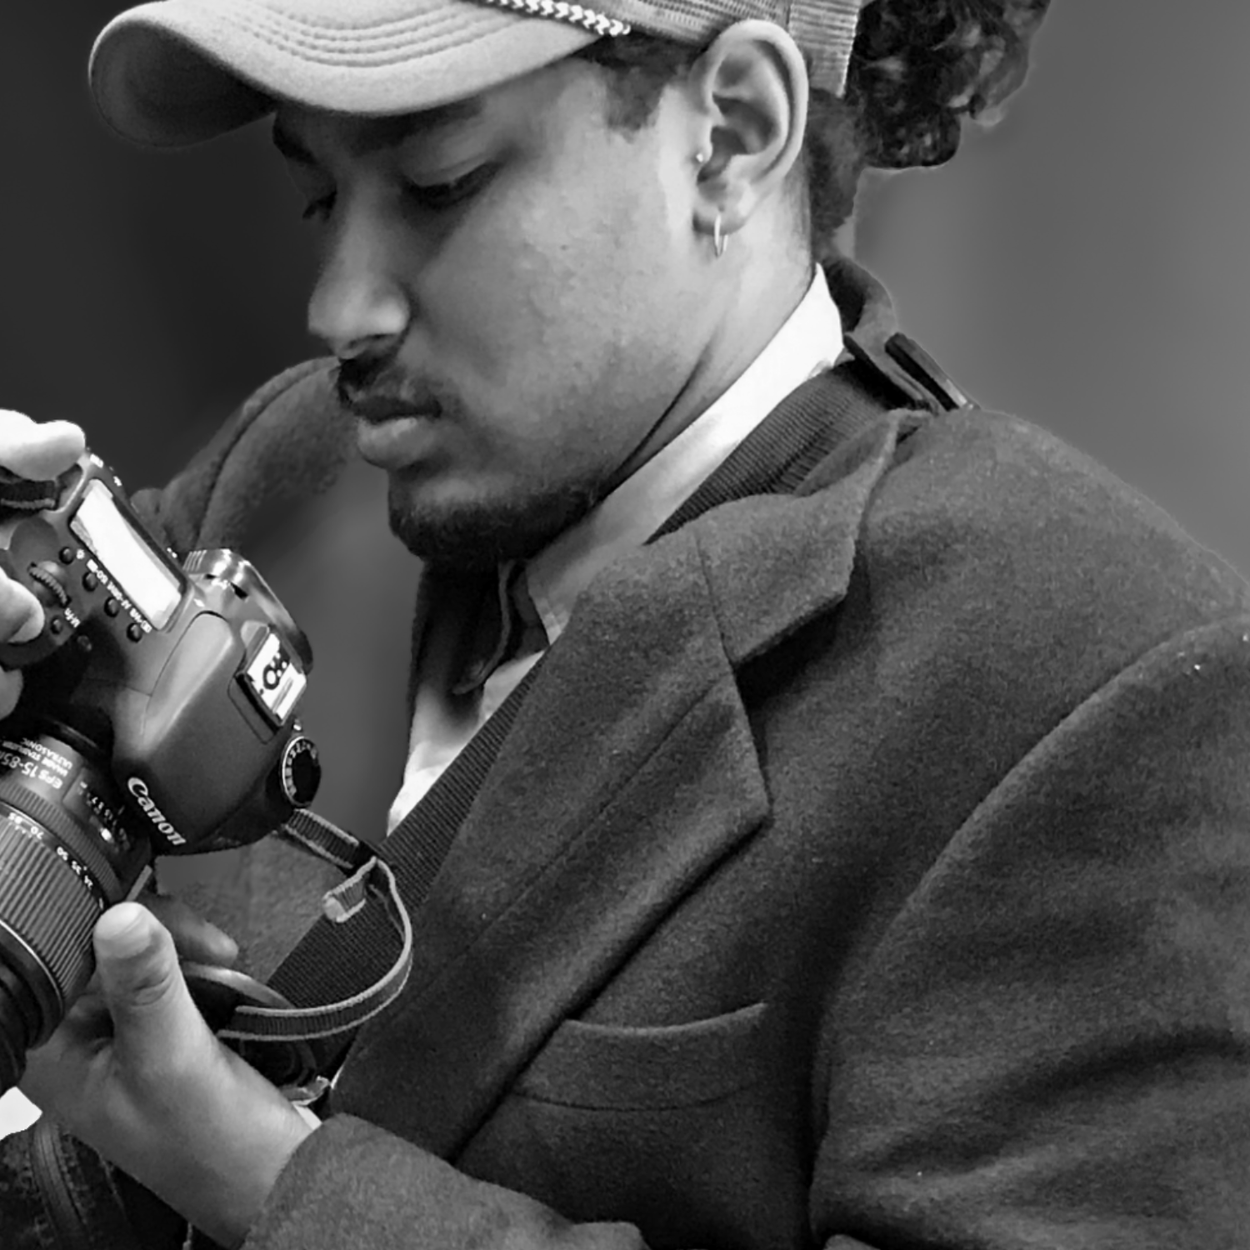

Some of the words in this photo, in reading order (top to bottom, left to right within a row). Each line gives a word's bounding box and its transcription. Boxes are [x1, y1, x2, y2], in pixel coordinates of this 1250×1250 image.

[38, 769, 63, 789] EFS
[128, 777, 186, 845] Canon
[30, 826, 44, 840] 70
